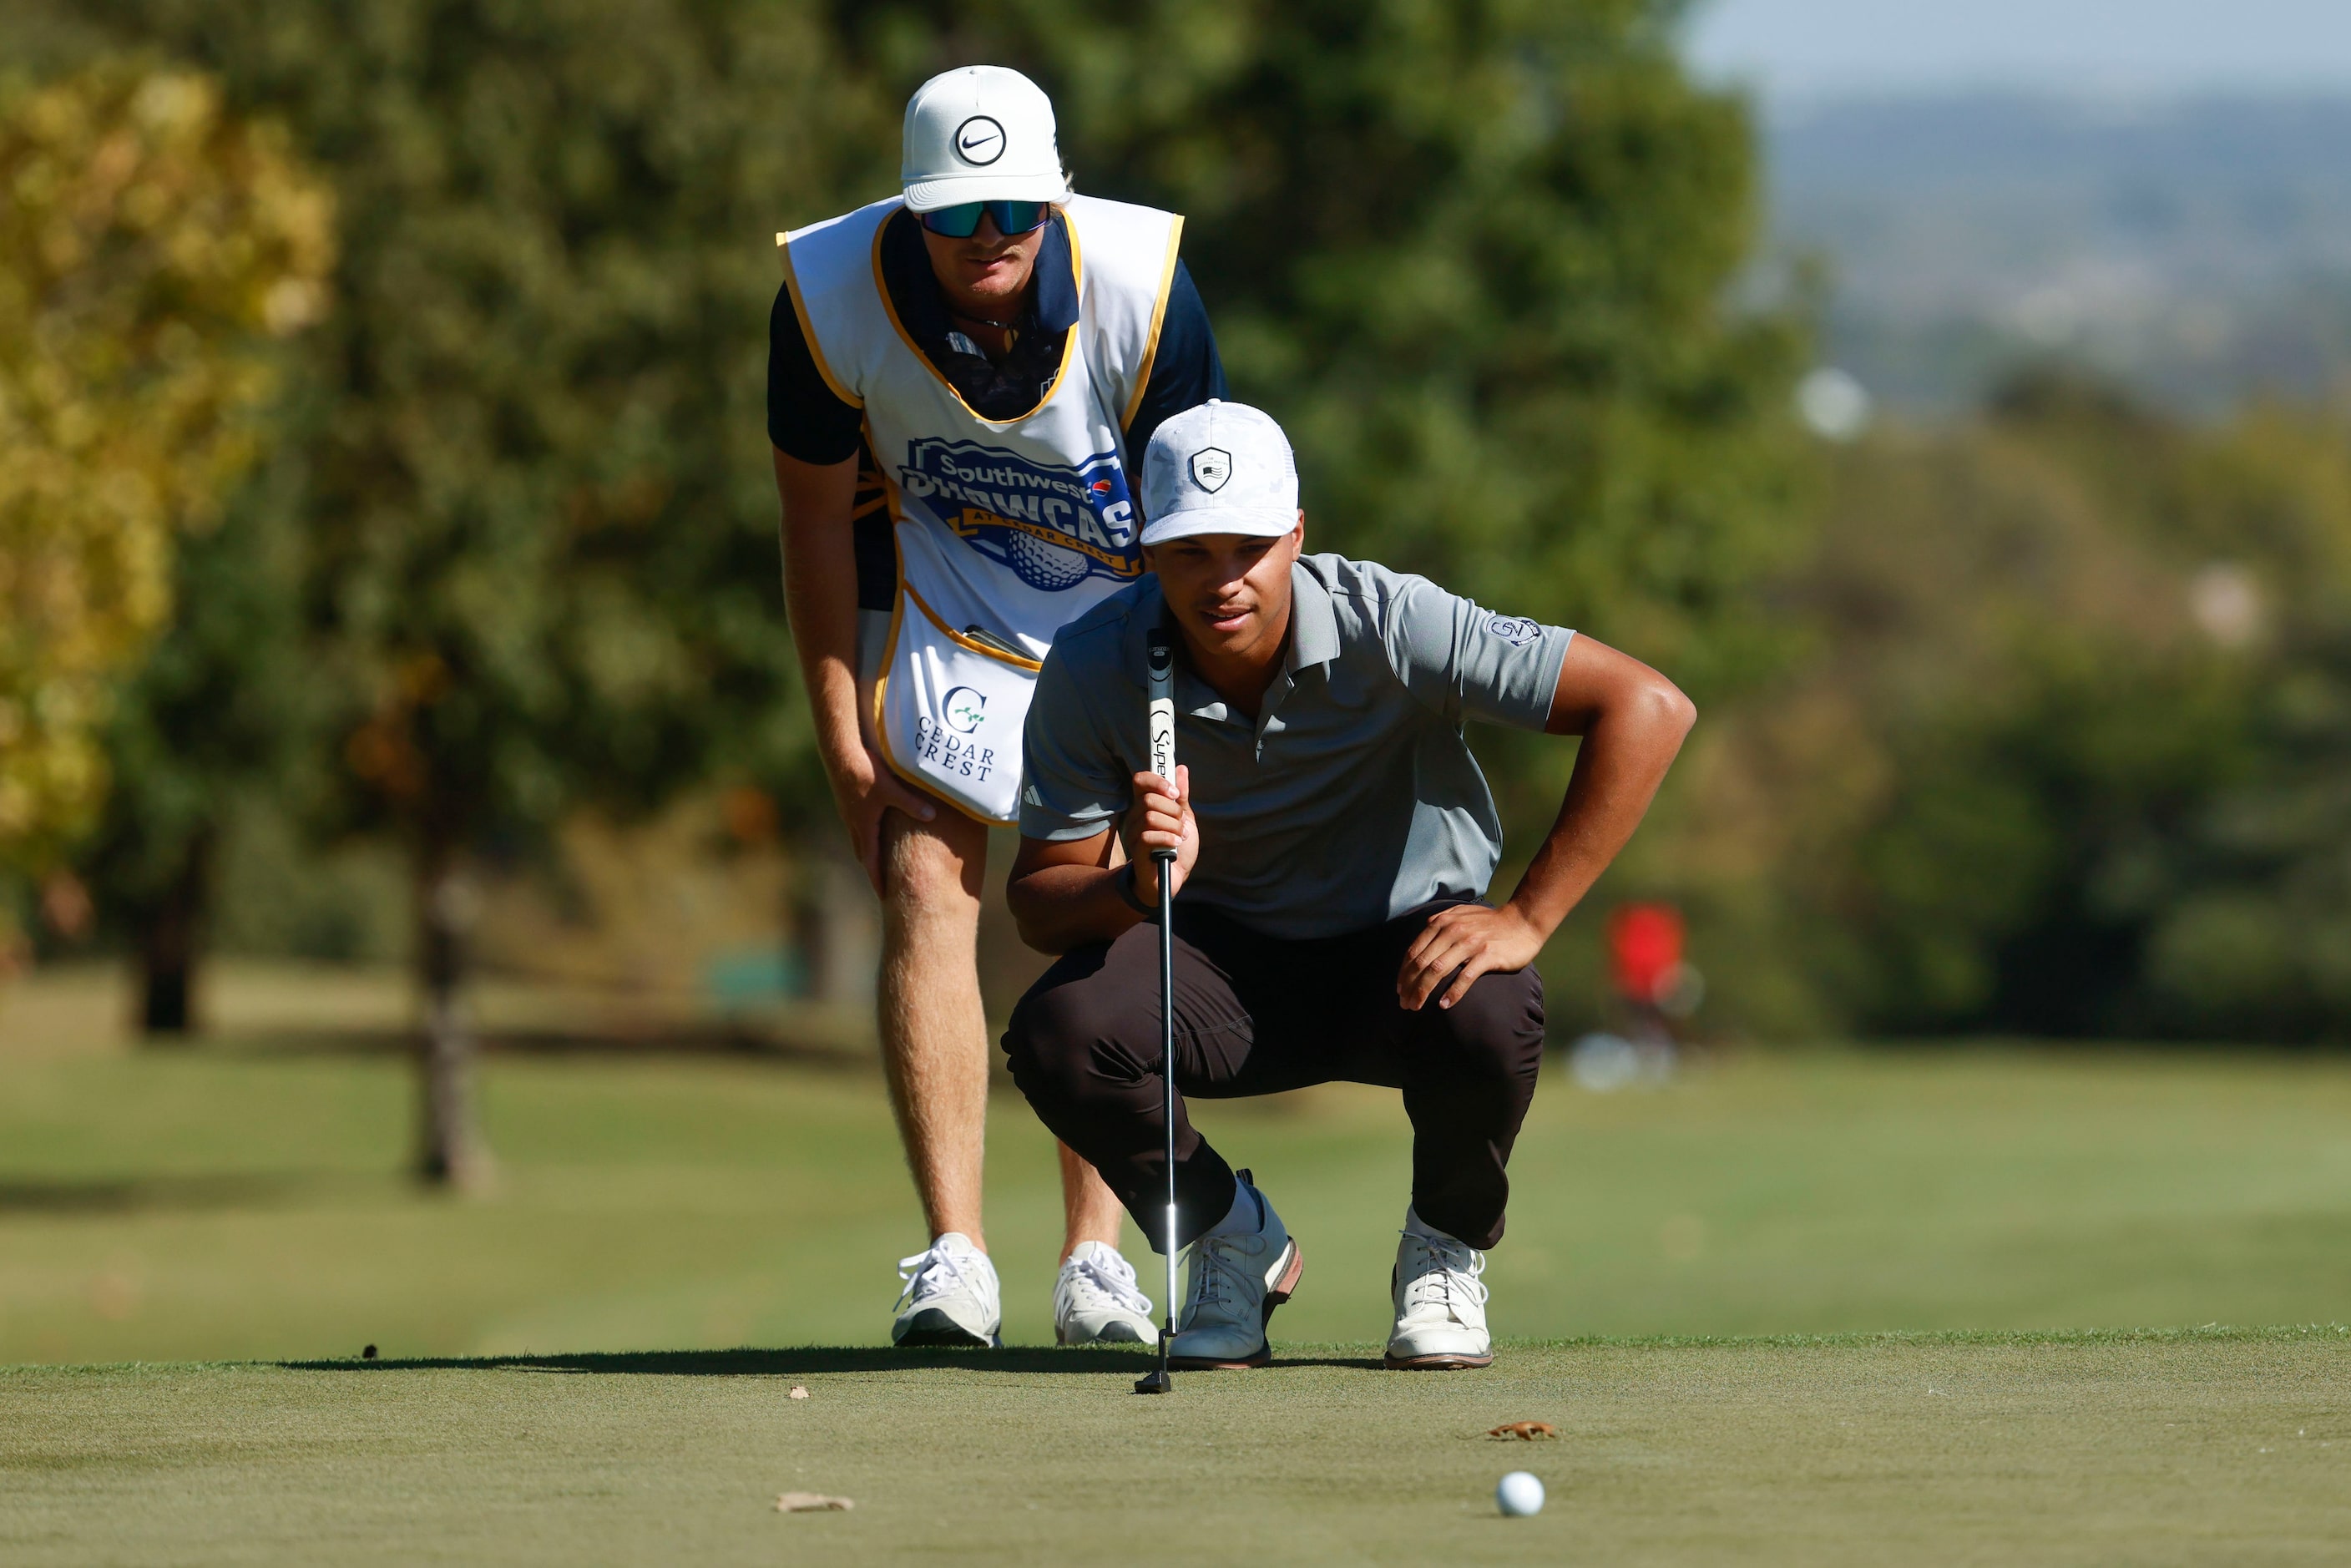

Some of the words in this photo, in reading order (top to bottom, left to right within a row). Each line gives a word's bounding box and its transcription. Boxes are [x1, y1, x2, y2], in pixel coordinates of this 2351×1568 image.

[940, 453, 1094, 504] Southwest
[902, 467, 1137, 548] SHOWCAS
[973, 511, 993, 521] AT
[1002, 518, 1055, 540] CEDAR
[1064, 538, 1114, 564] CREST
[915, 732, 992, 782] CREST
[919, 716, 993, 765] CEDAR
[1151, 726, 1170, 777] Supe
